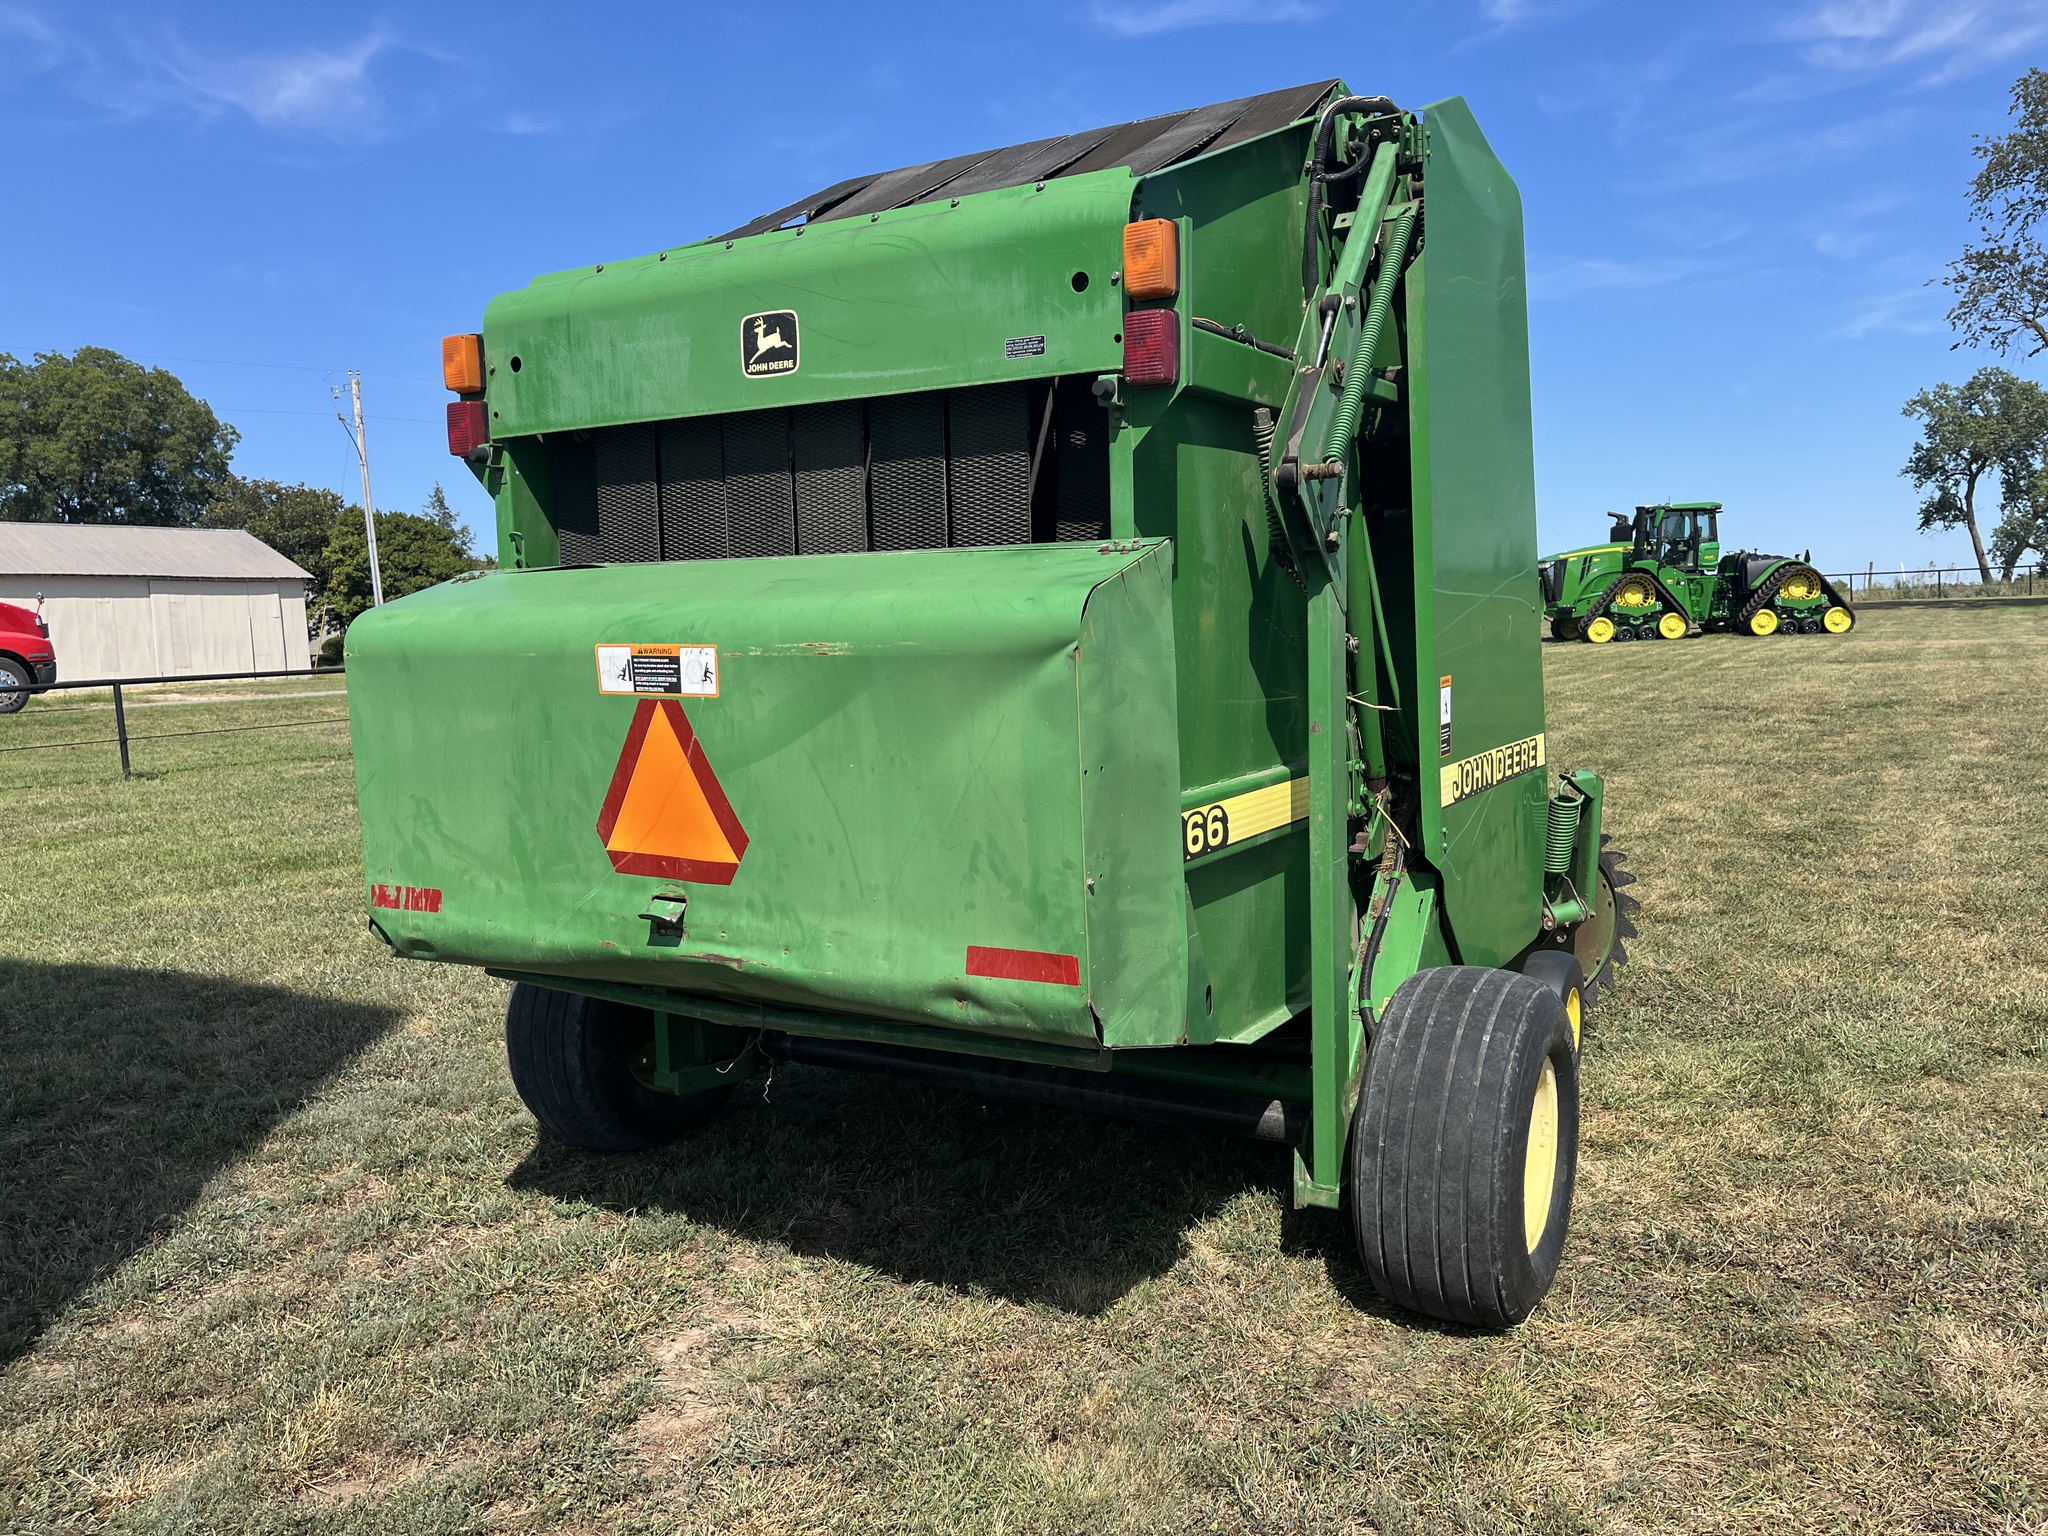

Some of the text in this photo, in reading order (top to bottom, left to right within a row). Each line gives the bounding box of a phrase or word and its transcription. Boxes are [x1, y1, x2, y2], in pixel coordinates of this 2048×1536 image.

[747, 360, 794, 373] JOHN DEERE
[1452, 738, 1537, 800] JOHN DEERE
